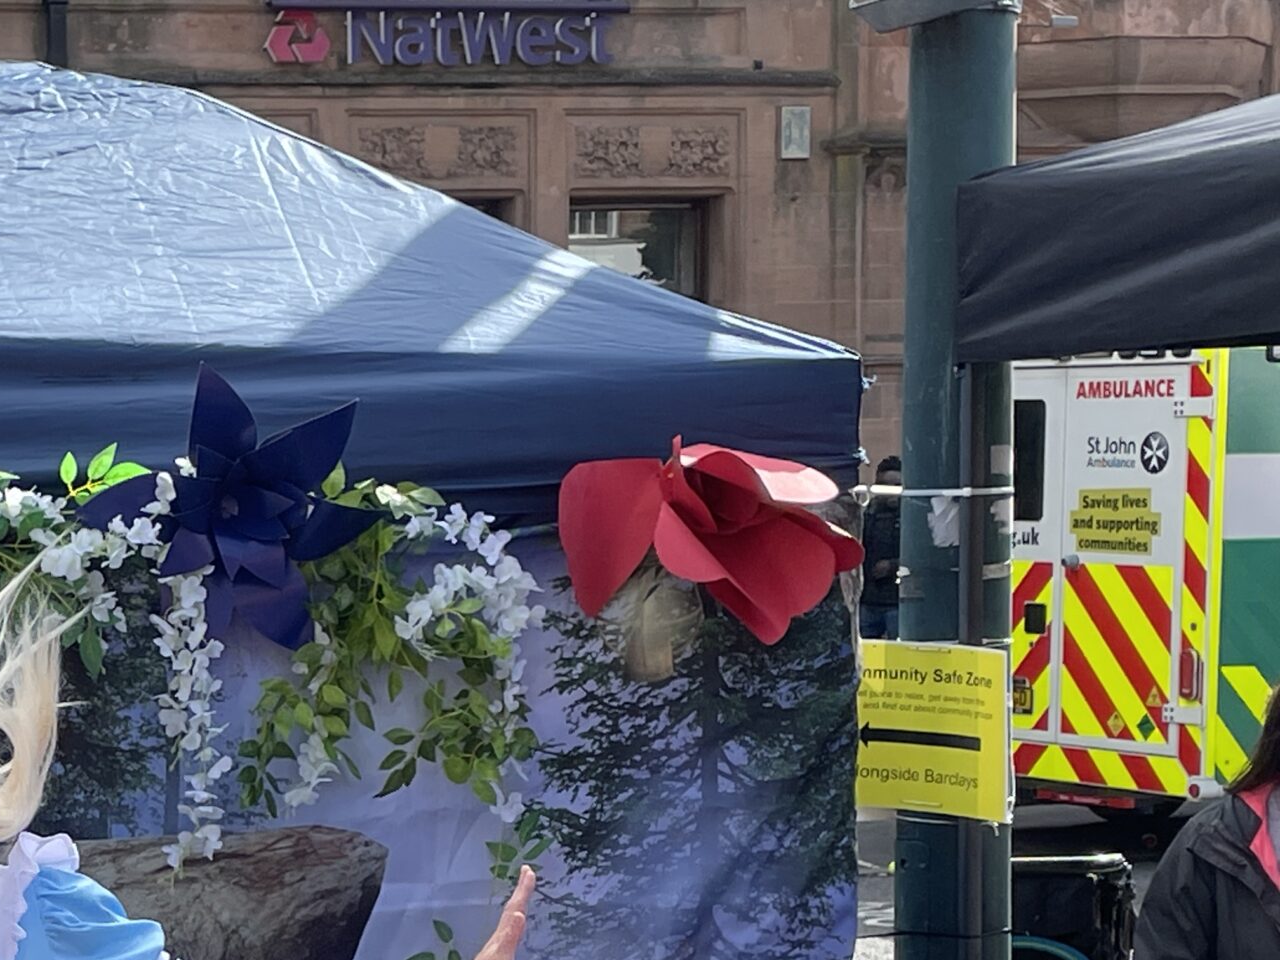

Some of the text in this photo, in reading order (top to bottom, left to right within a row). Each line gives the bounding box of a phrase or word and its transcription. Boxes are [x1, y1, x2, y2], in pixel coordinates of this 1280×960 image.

[345, 11, 614, 66] NatWest
[1076, 379, 1176, 400] AMBULANCE
[1087, 437, 1137, 456] St John
[1086, 456, 1136, 469] Ambulance
[1082, 494, 1148, 512] Saving lives
[1072, 516, 1159, 535] and supporting
[1078, 537, 1148, 552] communities
[933, 669, 963, 685] Safe
[965, 672, 992, 689] Zone
[924, 768, 978, 791] Barclays
